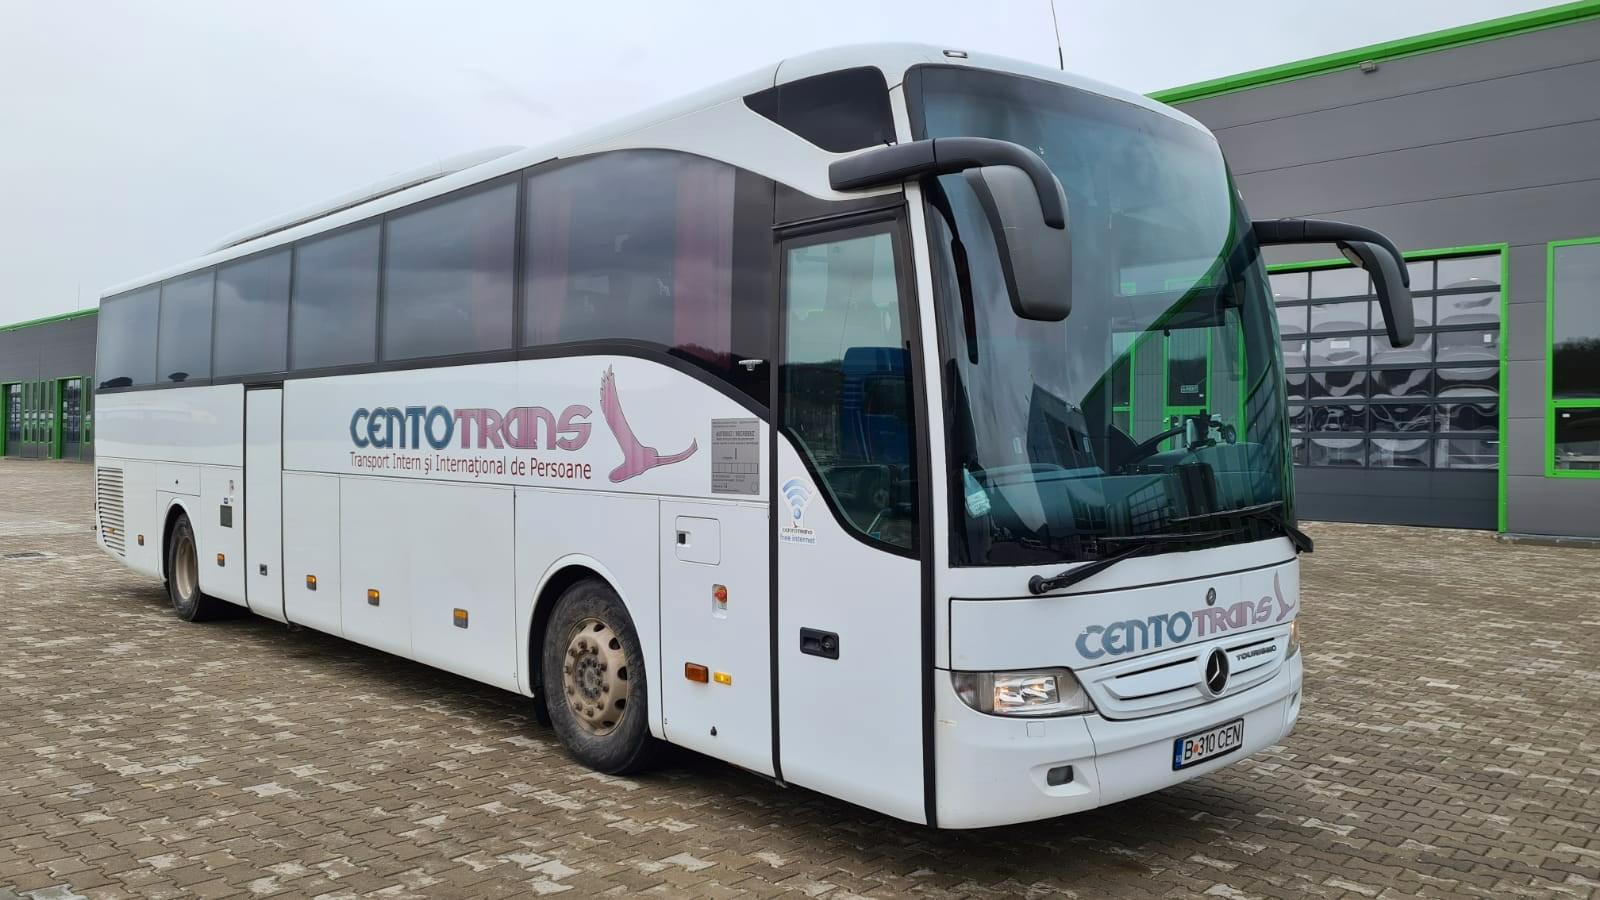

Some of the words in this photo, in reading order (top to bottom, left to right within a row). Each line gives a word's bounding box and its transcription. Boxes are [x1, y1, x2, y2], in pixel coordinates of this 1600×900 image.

[350, 451, 390, 471] Transport
[392, 453, 421, 470] Intern
[510, 456, 526, 476] de
[530, 457, 592, 480] Persoane
[1217, 724, 1241, 749] CEN
